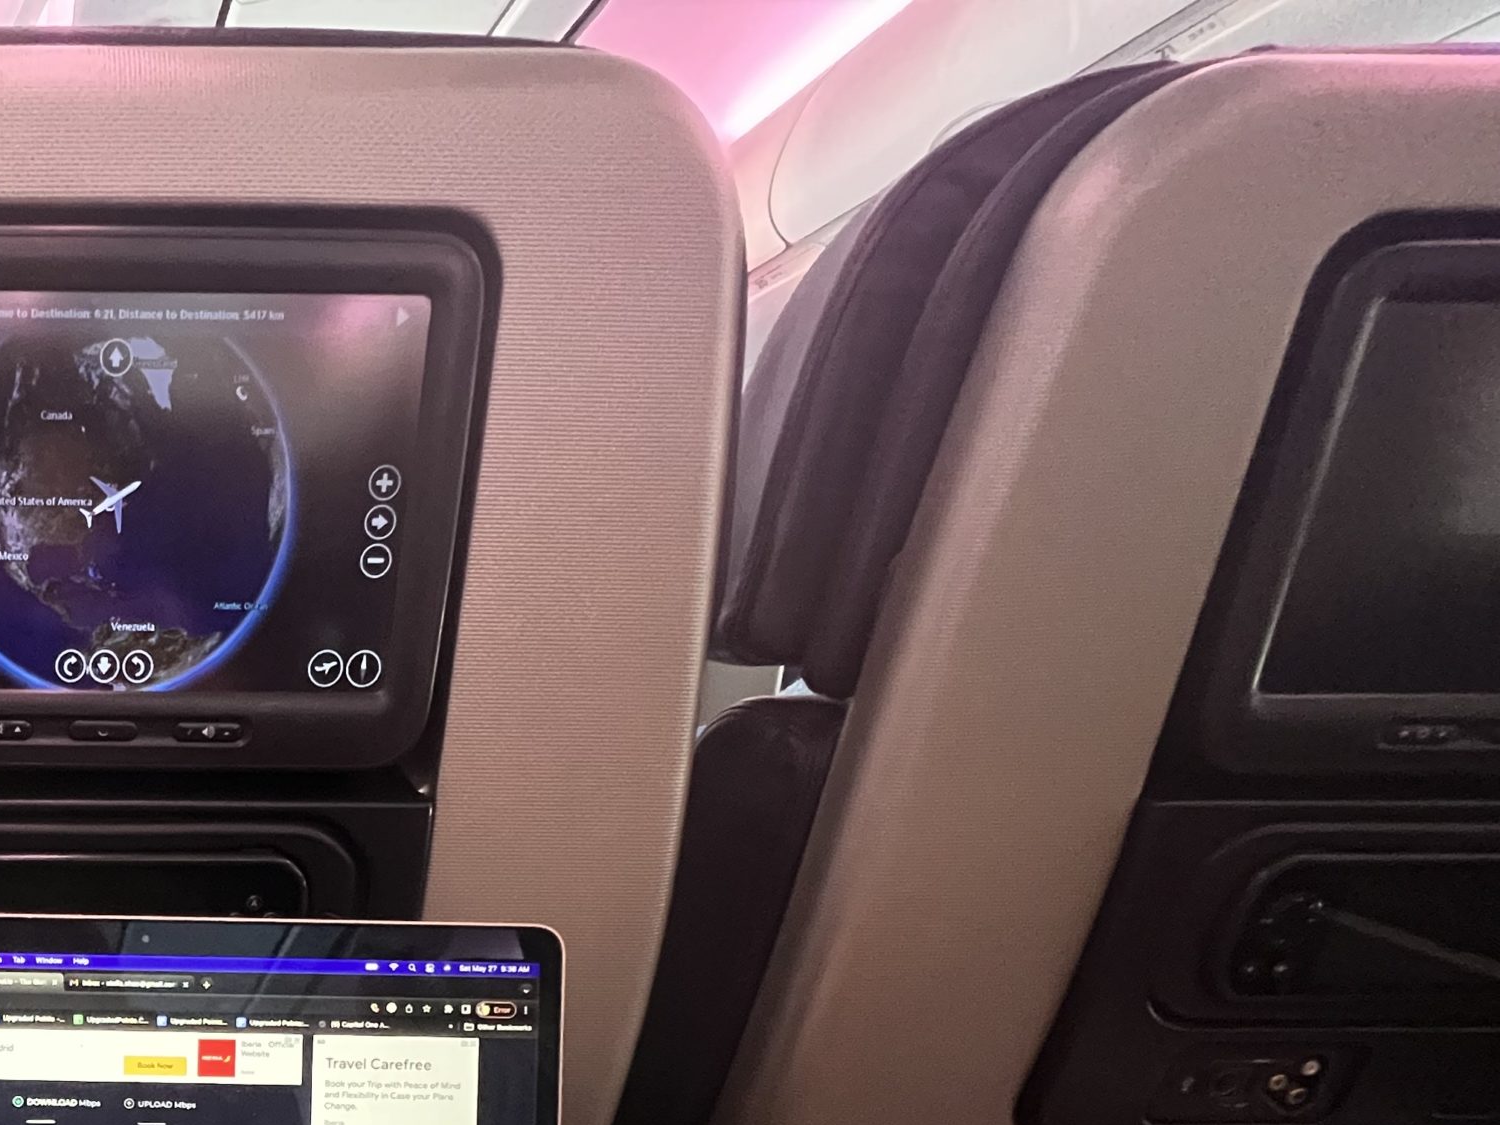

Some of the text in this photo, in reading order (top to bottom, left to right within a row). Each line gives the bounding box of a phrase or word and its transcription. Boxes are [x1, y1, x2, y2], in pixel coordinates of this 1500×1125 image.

[17, 308, 28, 318] to
[31, 308, 90, 319] Destination:
[119, 309, 163, 320] Distance
[165, 309, 177, 320] to
[269, 310, 284, 320] km
[40, 411, 73, 420] Canada
[18, 496, 44, 506] States
[46, 496, 55, 506] of
[58, 497, 92, 506] America
[111, 622, 155, 632] Venezuela
[13, 956, 25, 964] Tab
[36, 956, 63, 965] Window
[73, 957, 89, 966] Help
[472, 965, 487, 973] May
[518, 965, 530, 973] AM
[325, 1057, 432, 1071] Travel Carefree
[325, 1080, 346, 1088] Book
[347, 1081, 365, 1090] your
[367, 1080, 382, 1090] Trip
[384, 1081, 402, 1089] with
[403, 1081, 428, 1089] Peace
[441, 1082, 461, 1090] Mind
[324, 1091, 339, 1099] and
[342, 1091, 379, 1100] Flexibility
[390, 1092, 411, 1100] Case
[413, 1093, 430, 1101] your
[433, 1093, 454, 1101] Plans
[26, 1098, 101, 1108] DOWNLOAD Mbps
[138, 1101, 196, 1110] UPLOAD Mbps
[324, 1102, 357, 1111] Change.
